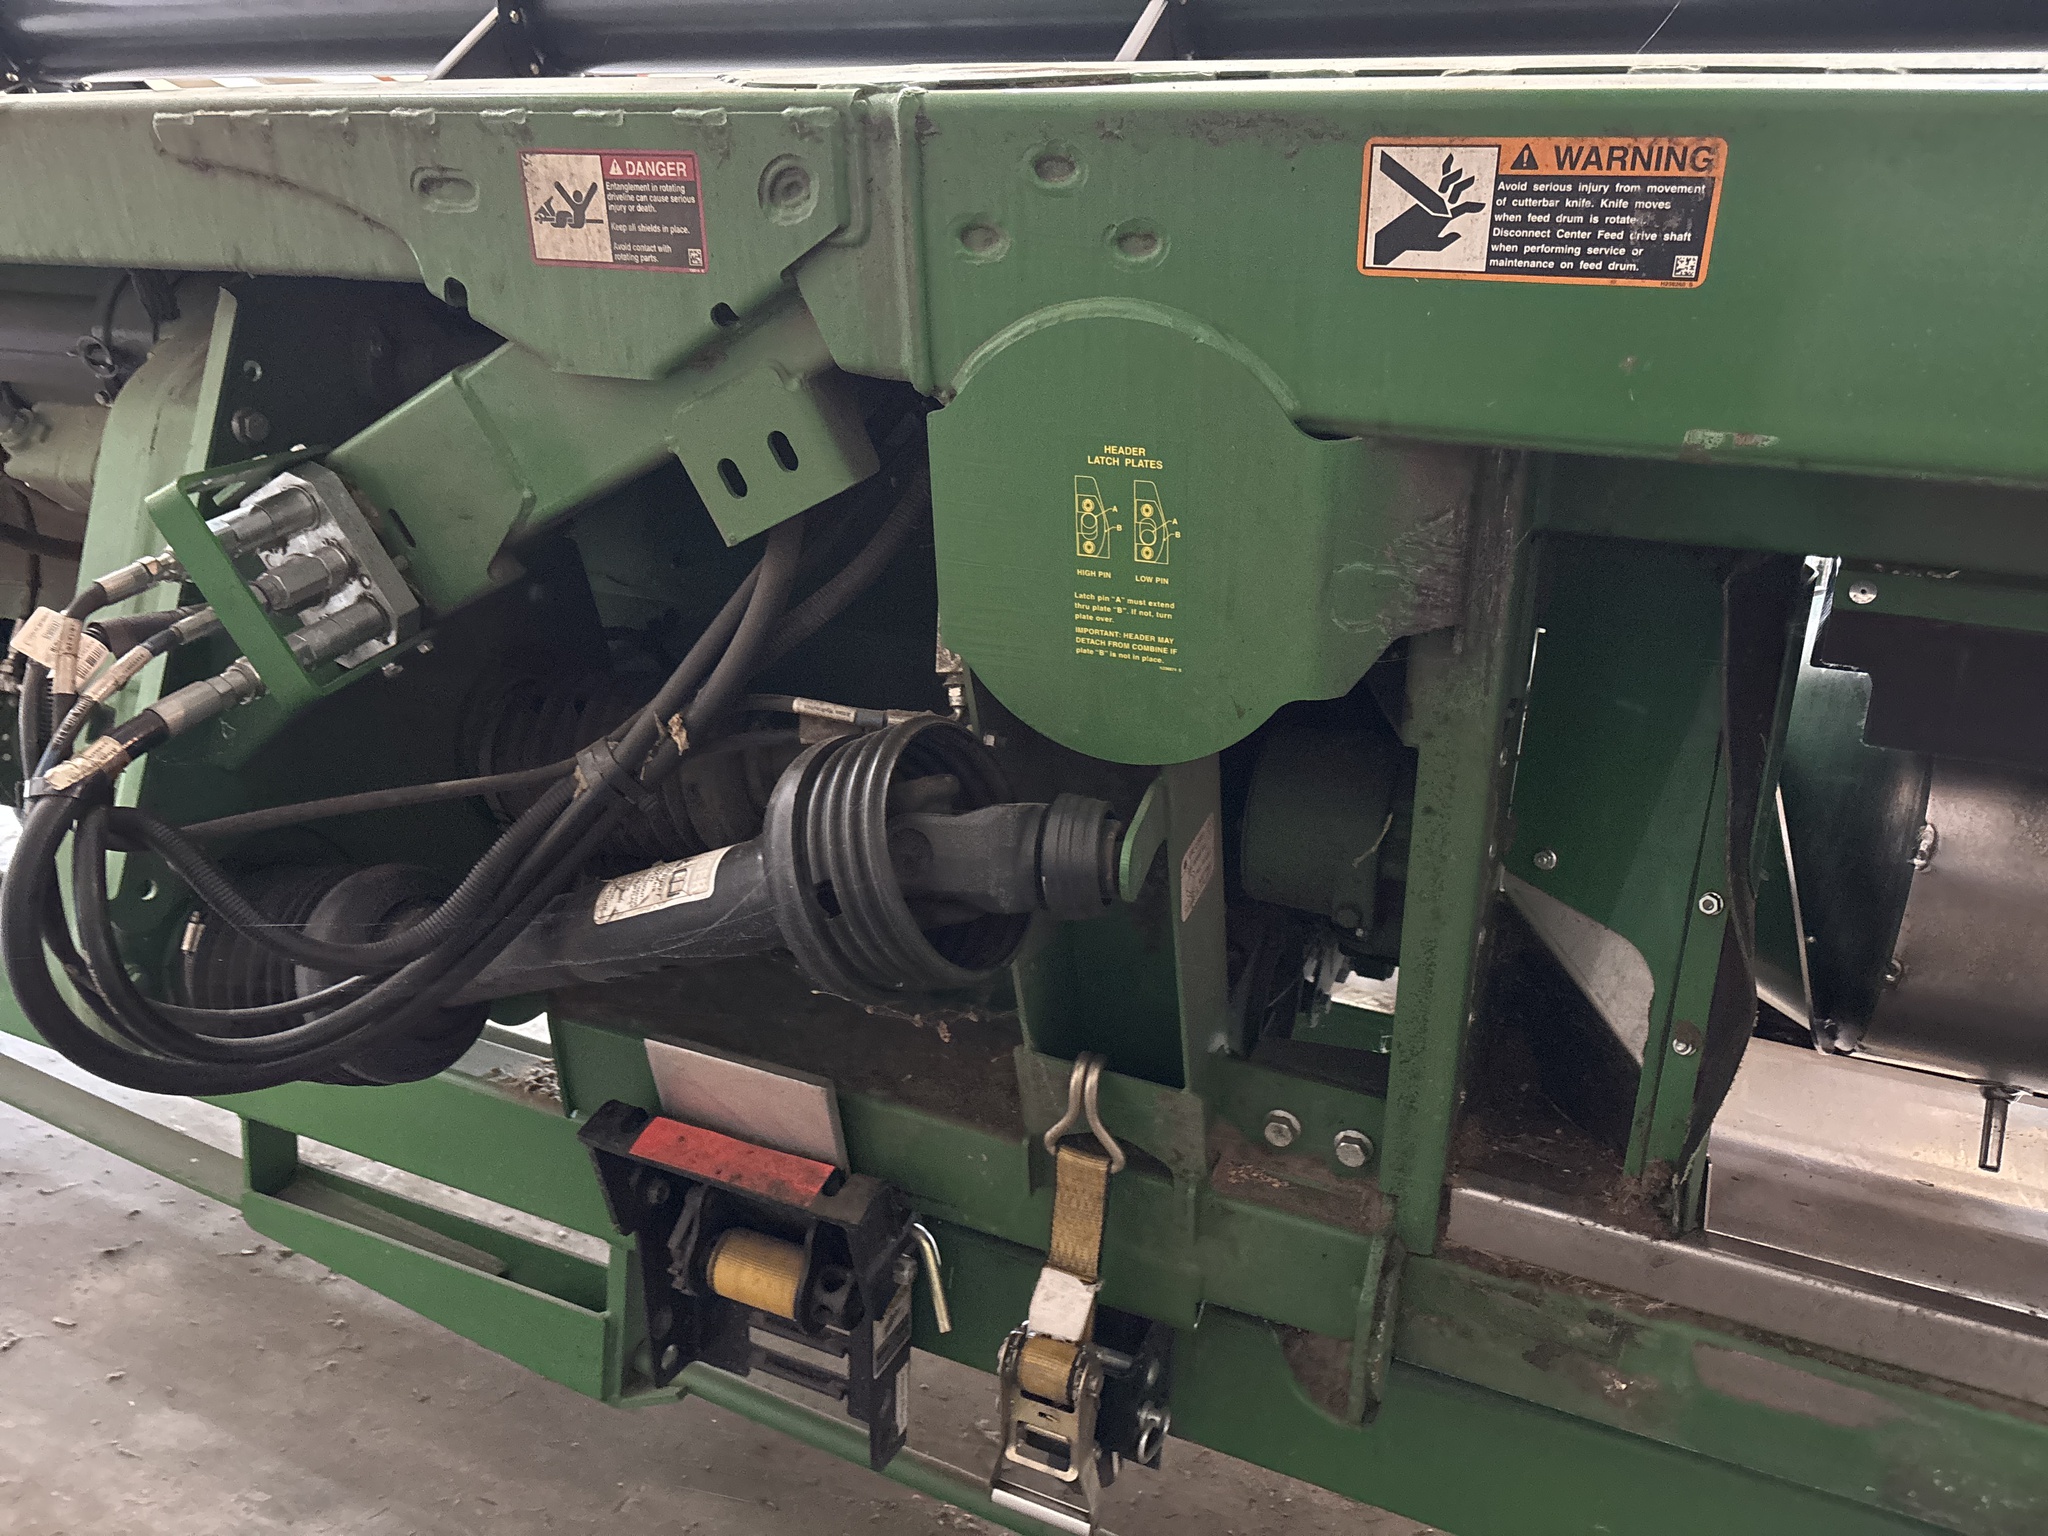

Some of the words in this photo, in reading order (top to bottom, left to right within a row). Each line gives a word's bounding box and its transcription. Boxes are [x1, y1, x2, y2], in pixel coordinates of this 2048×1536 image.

[1554, 145, 1714, 172] WARNING
[1497, 181, 1527, 191] Avoid
[1532, 182, 1572, 192] serious
[1578, 182, 1609, 194] injury
[1615, 183, 1640, 192] from
[1646, 184, 1706, 194] movement
[1495, 197, 1506, 206] of
[1511, 198, 1560, 207] cutterbar
[1600, 199, 1629, 208] Knife
[1634, 200, 1671, 209] moves
[1494, 213, 1521, 222] when
[1527, 213, 1550, 222] feed
[1555, 214, 1583, 223] drum
[1589, 214, 1599, 223] is
[1492, 227, 1551, 238] Disconnect
[1556, 229, 1592, 239] Center
[1597, 229, 1624, 240] Feed
[1629, 230, 1657, 240] drive
[1663, 231, 1692, 241] shaft
[1490, 243, 1518, 252] when
[1523, 244, 1581, 256] performing
[1586, 246, 1626, 255] service
[1489, 258, 1555, 268] maintenance
[1560, 261, 1573, 269] on
[1579, 260, 1602, 270] feed
[1607, 261, 1639, 271] drum.
[1103, 445, 1146, 456] HEADER
[1087, 455, 1119, 466] LATCH
[1124, 458, 1163, 470] PLATES
[1076, 569, 1096, 577] HIGH
[1098, 570, 1111, 579] PIN
[1135, 575, 1153, 583] LOW
[1155, 576, 1169, 584] PIN
[1074, 592, 1095, 600] Latch
[1127, 598, 1146, 606] must
[1148, 601, 1175, 609] extend
[1074, 602, 1090, 610] thru
[1092, 604, 1111, 612] plate
[1156, 611, 1172, 619] turn
[1075, 626, 1121, 638] IMPORTANT:
[1123, 632, 1156, 642] HEADER
[1157, 636, 1174, 644] MAY
[1075, 637, 1106, 646] DETACH
[1107, 640, 1130, 649] FROM
[1131, 644, 1168, 654] COMBINE
[1075, 647, 1094, 655] plate
[1142, 656, 1164, 664] place.
